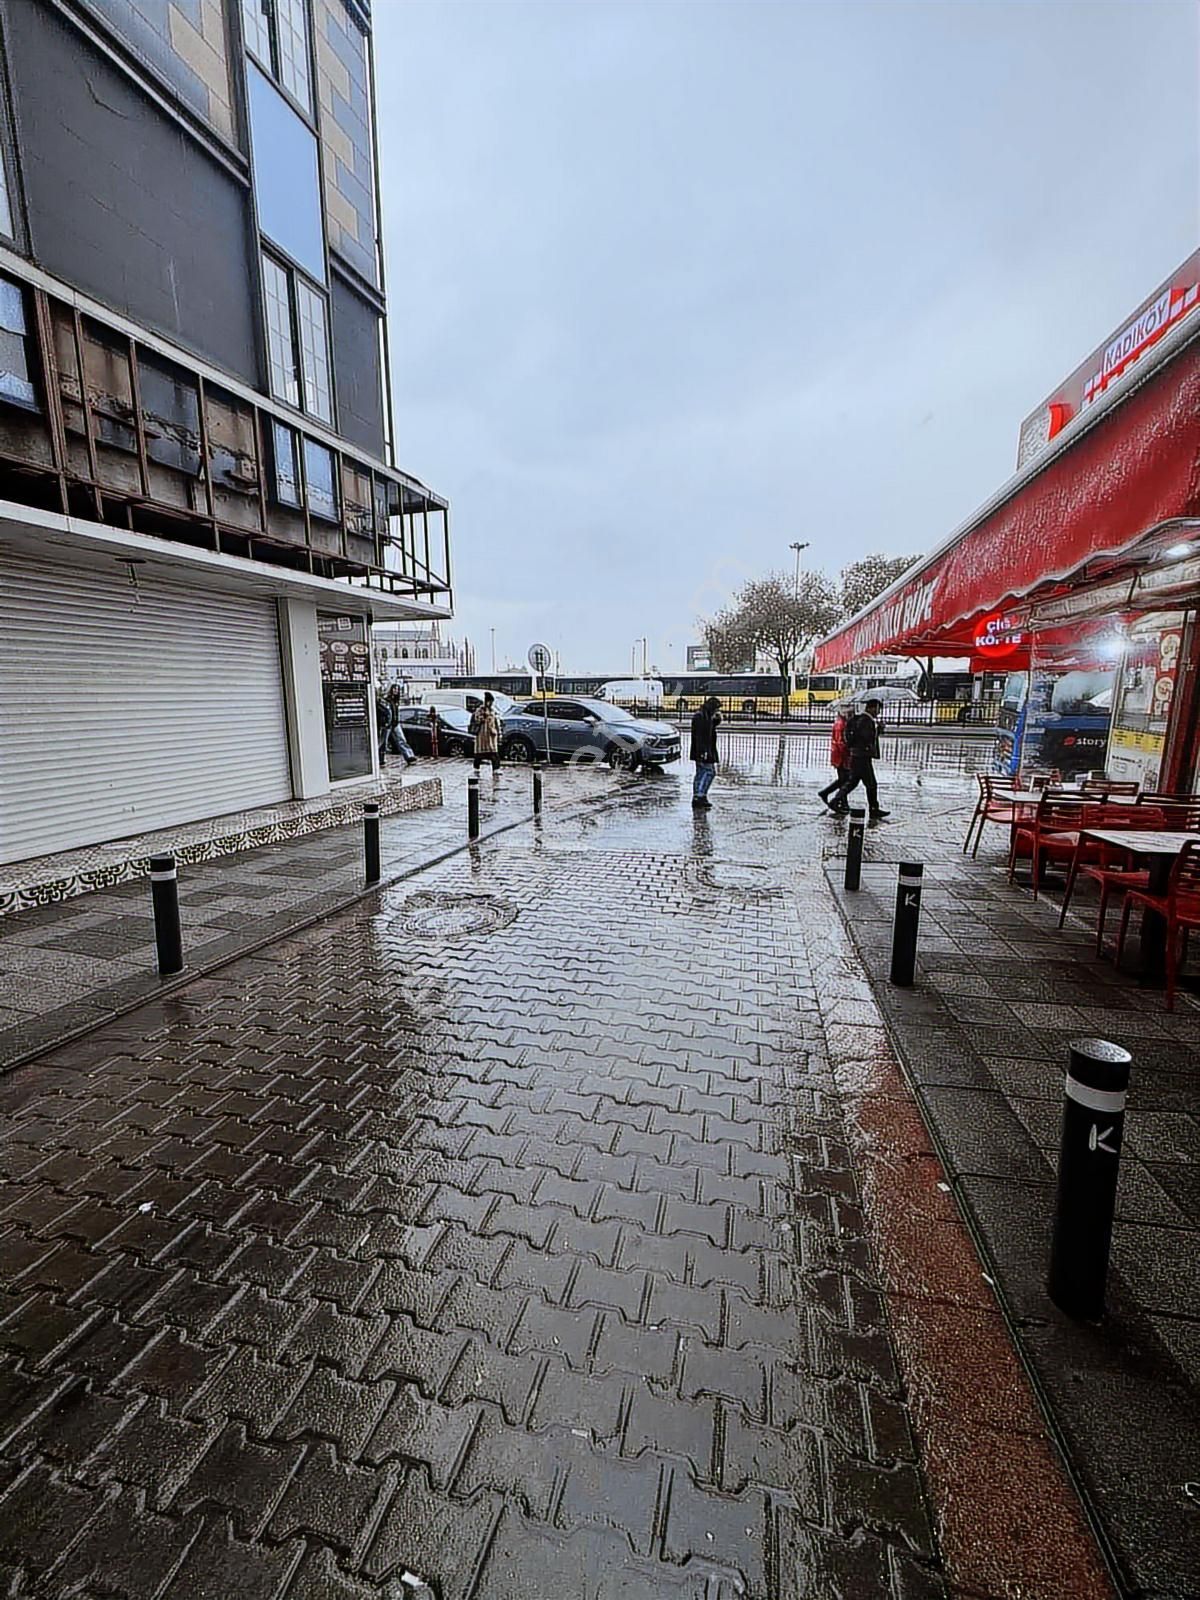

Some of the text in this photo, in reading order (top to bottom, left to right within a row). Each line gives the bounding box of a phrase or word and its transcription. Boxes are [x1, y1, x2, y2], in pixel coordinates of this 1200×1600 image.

[1105, 298, 1169, 373] KADIKÖY
[1076, 737, 1106, 748] story
[904, 892, 918, 907] K
[1088, 1123, 1118, 1154] K
